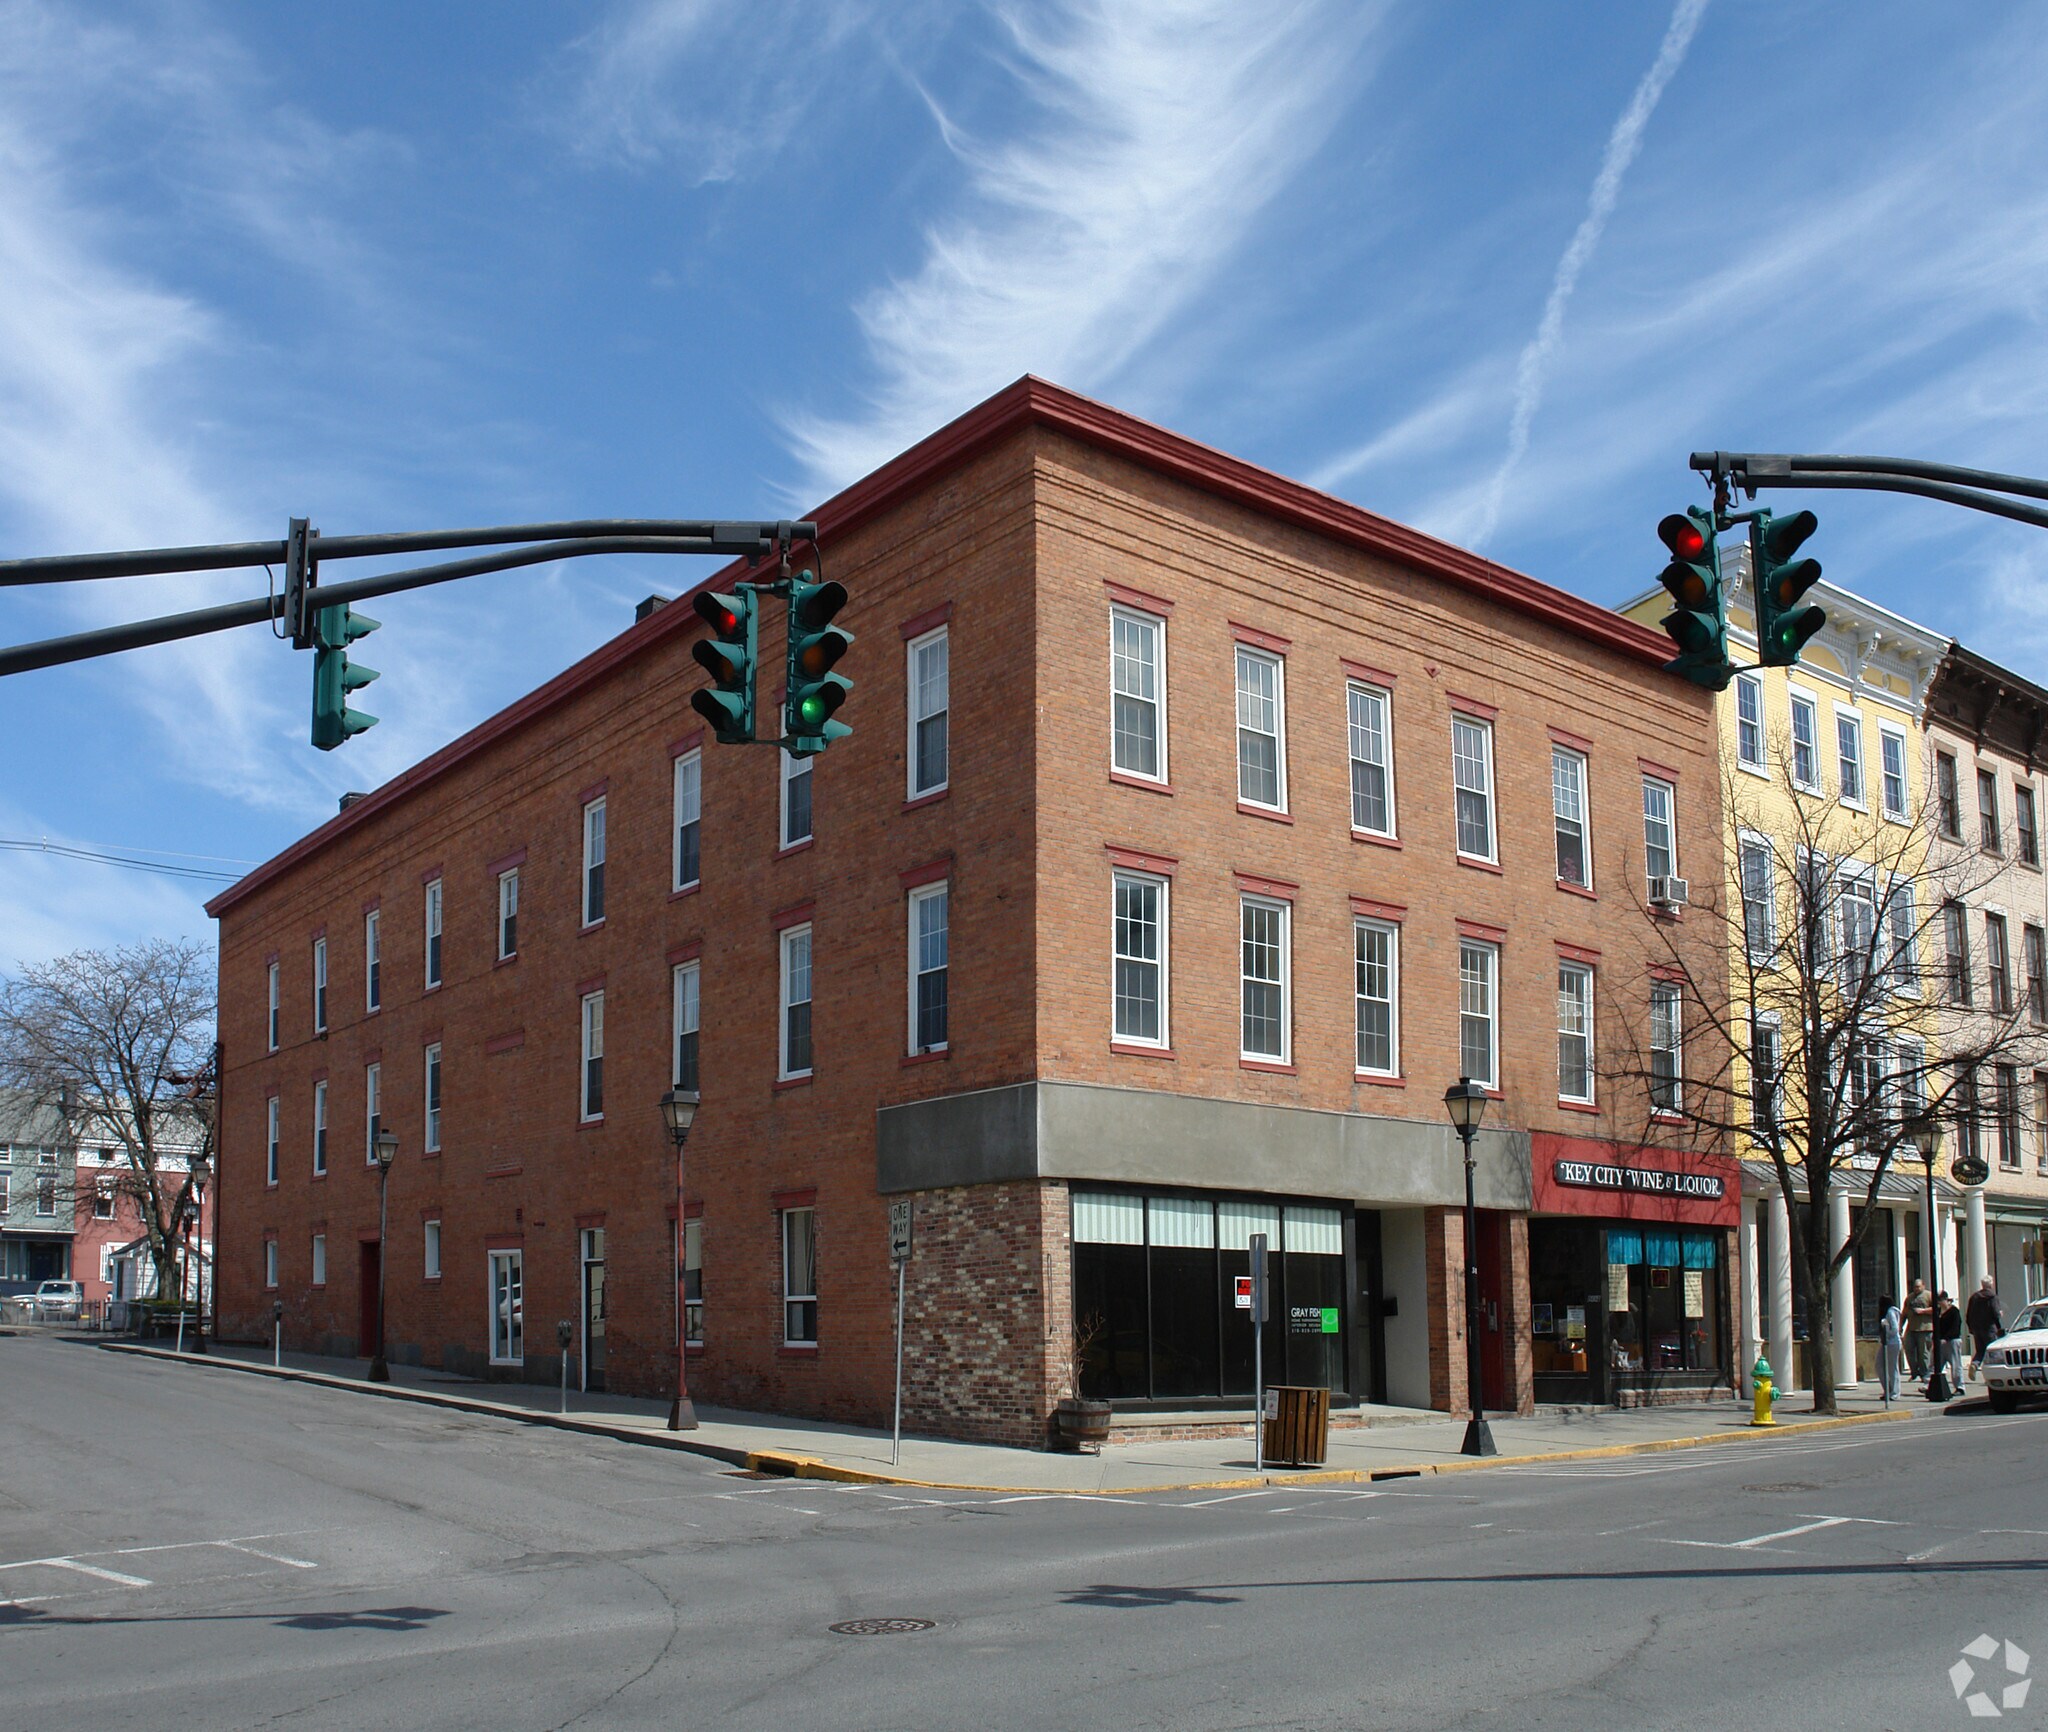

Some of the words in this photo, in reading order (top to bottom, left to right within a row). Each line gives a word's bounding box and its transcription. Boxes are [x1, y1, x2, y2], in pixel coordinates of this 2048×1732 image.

[1560, 1162, 1593, 1183] KEY
[1595, 1166, 1624, 1186] CITY
[1626, 1169, 1665, 1190] WINE
[1665, 1176, 1674, 1189] &
[1674, 1174, 1722, 1196] LIQUOR
[894, 1204, 907, 1221] ONE
[893, 1221, 907, 1235] WAY
[1291, 1307, 1308, 1317] GRAY
[1309, 1307, 1321, 1318] FISH
